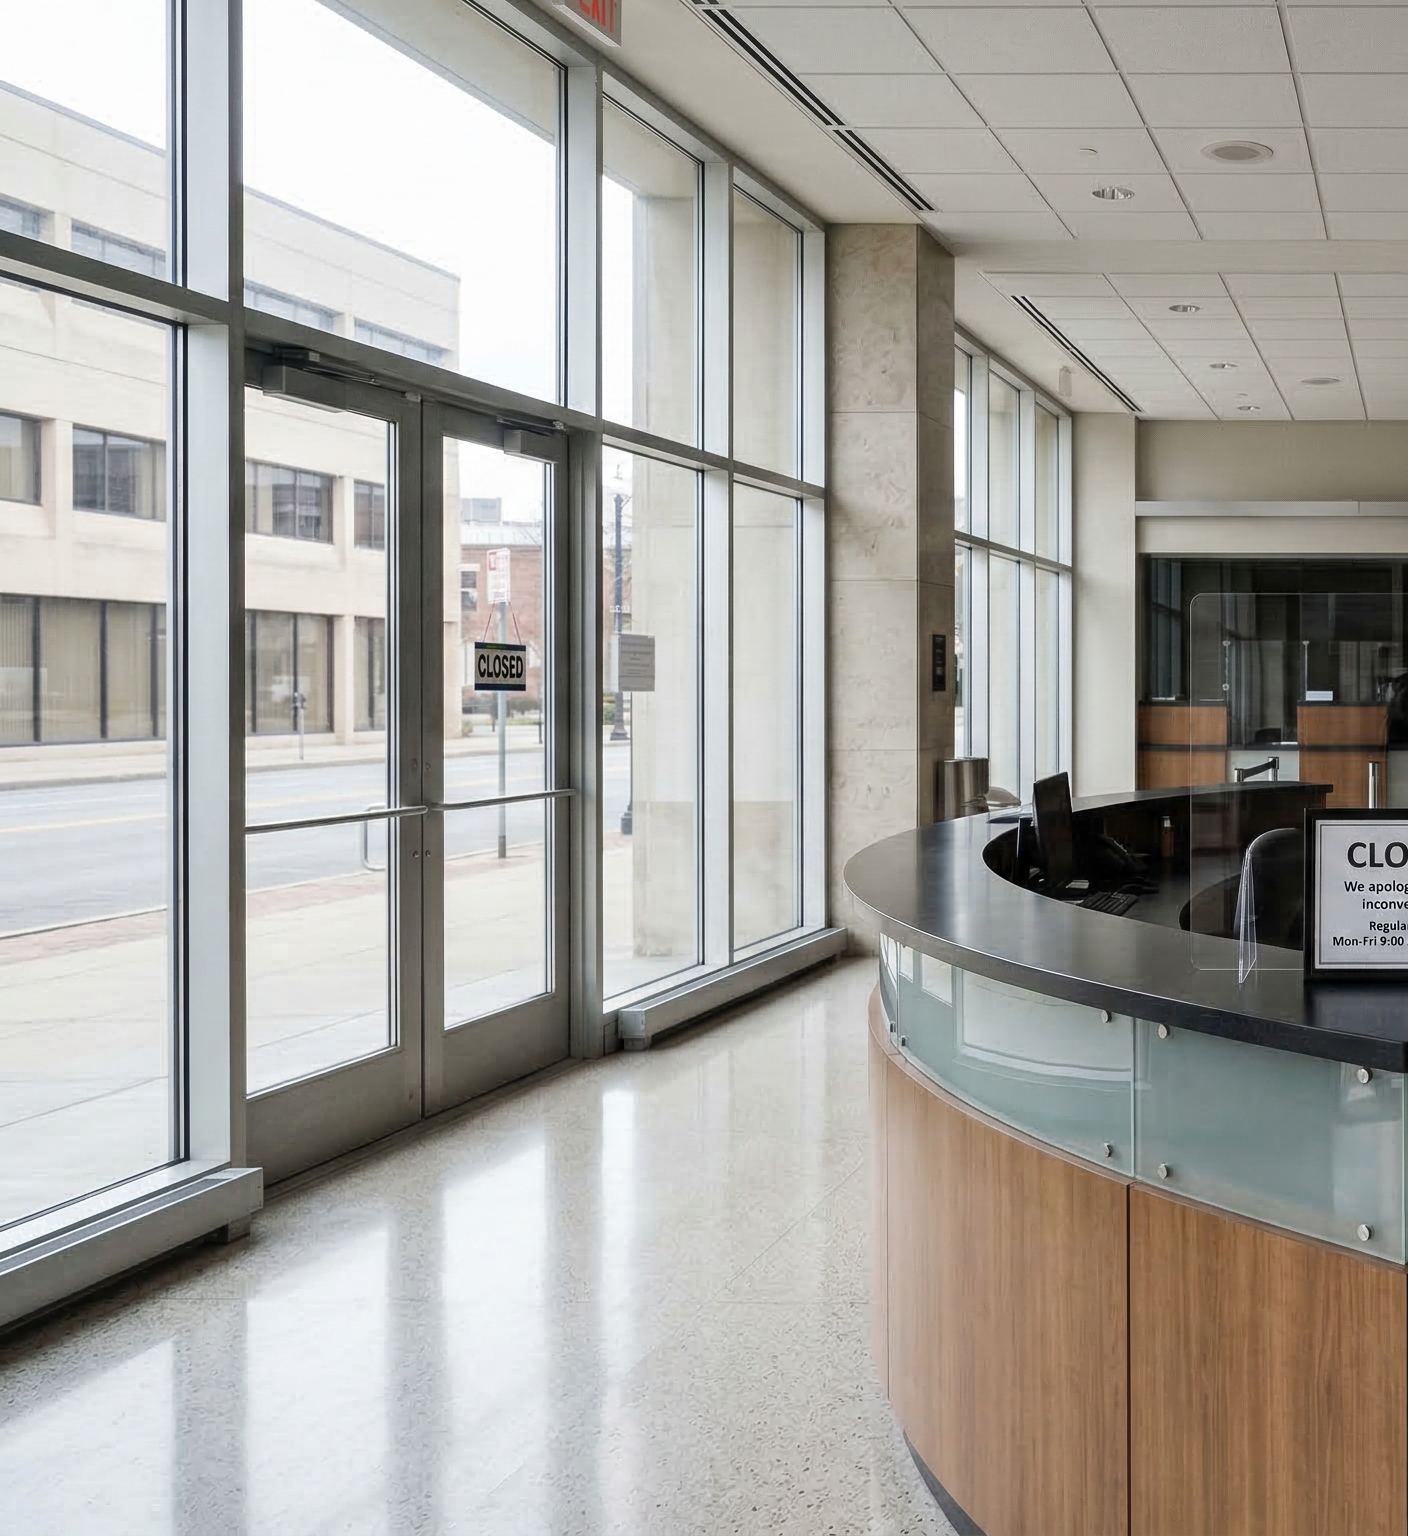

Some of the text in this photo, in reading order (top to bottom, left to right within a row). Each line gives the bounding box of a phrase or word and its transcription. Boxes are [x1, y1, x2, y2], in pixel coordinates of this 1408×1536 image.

[478, 653, 523, 679] CLOSED
[1344, 881, 1365, 892] We
[1332, 936, 1377, 946] Mon-Fri
[1379, 936, 1404, 946] 9:00
